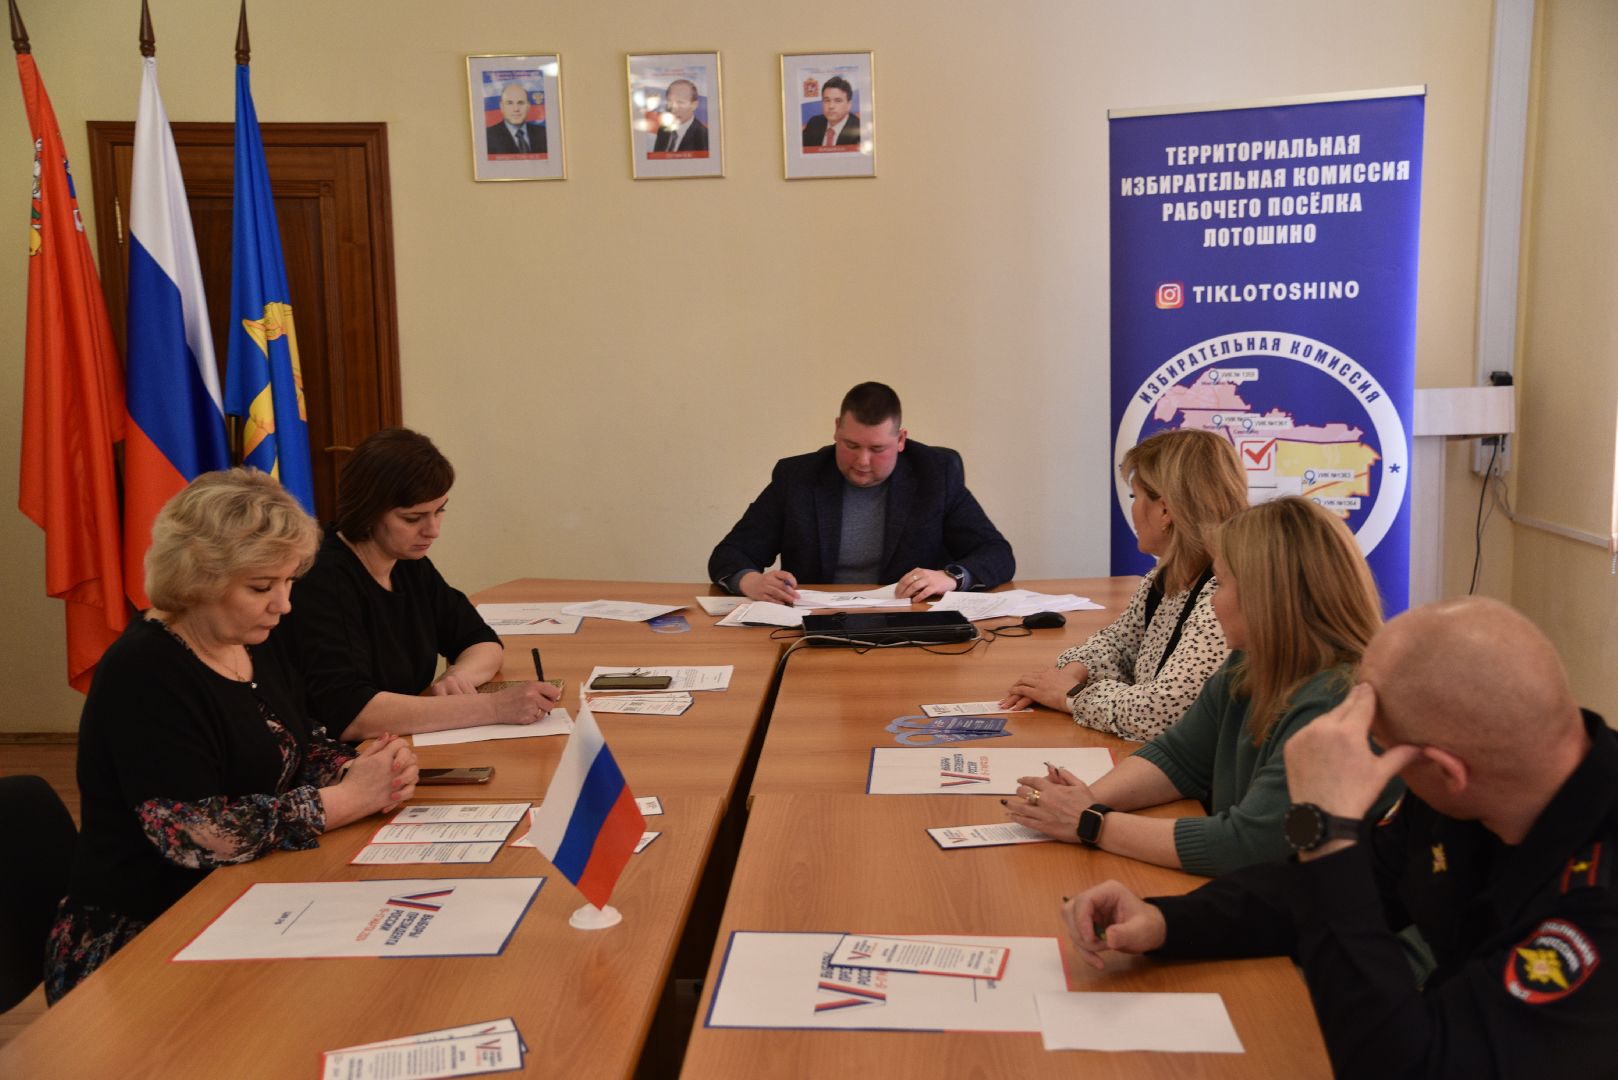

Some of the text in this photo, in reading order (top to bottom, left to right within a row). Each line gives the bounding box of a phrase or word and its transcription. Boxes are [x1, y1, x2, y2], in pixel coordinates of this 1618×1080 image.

[1165, 134, 1361, 166] ТЕРРИТОРИАЛЬНАЯ
[1121, 159, 1411, 197] ИЗБИРАТЕЛЬНАЯ КОМИССИЯ
[1162, 191, 1363, 222] РАБОЧЕГО ПОСЁЛКА
[1203, 223, 1317, 248] ЛОТОШИНО
[1192, 280, 1360, 304] TIKLOTOSHINO
[1139, 337, 1380, 404] ИЗБИРАТЕЛЬНАЯ КОМИССИЯ
